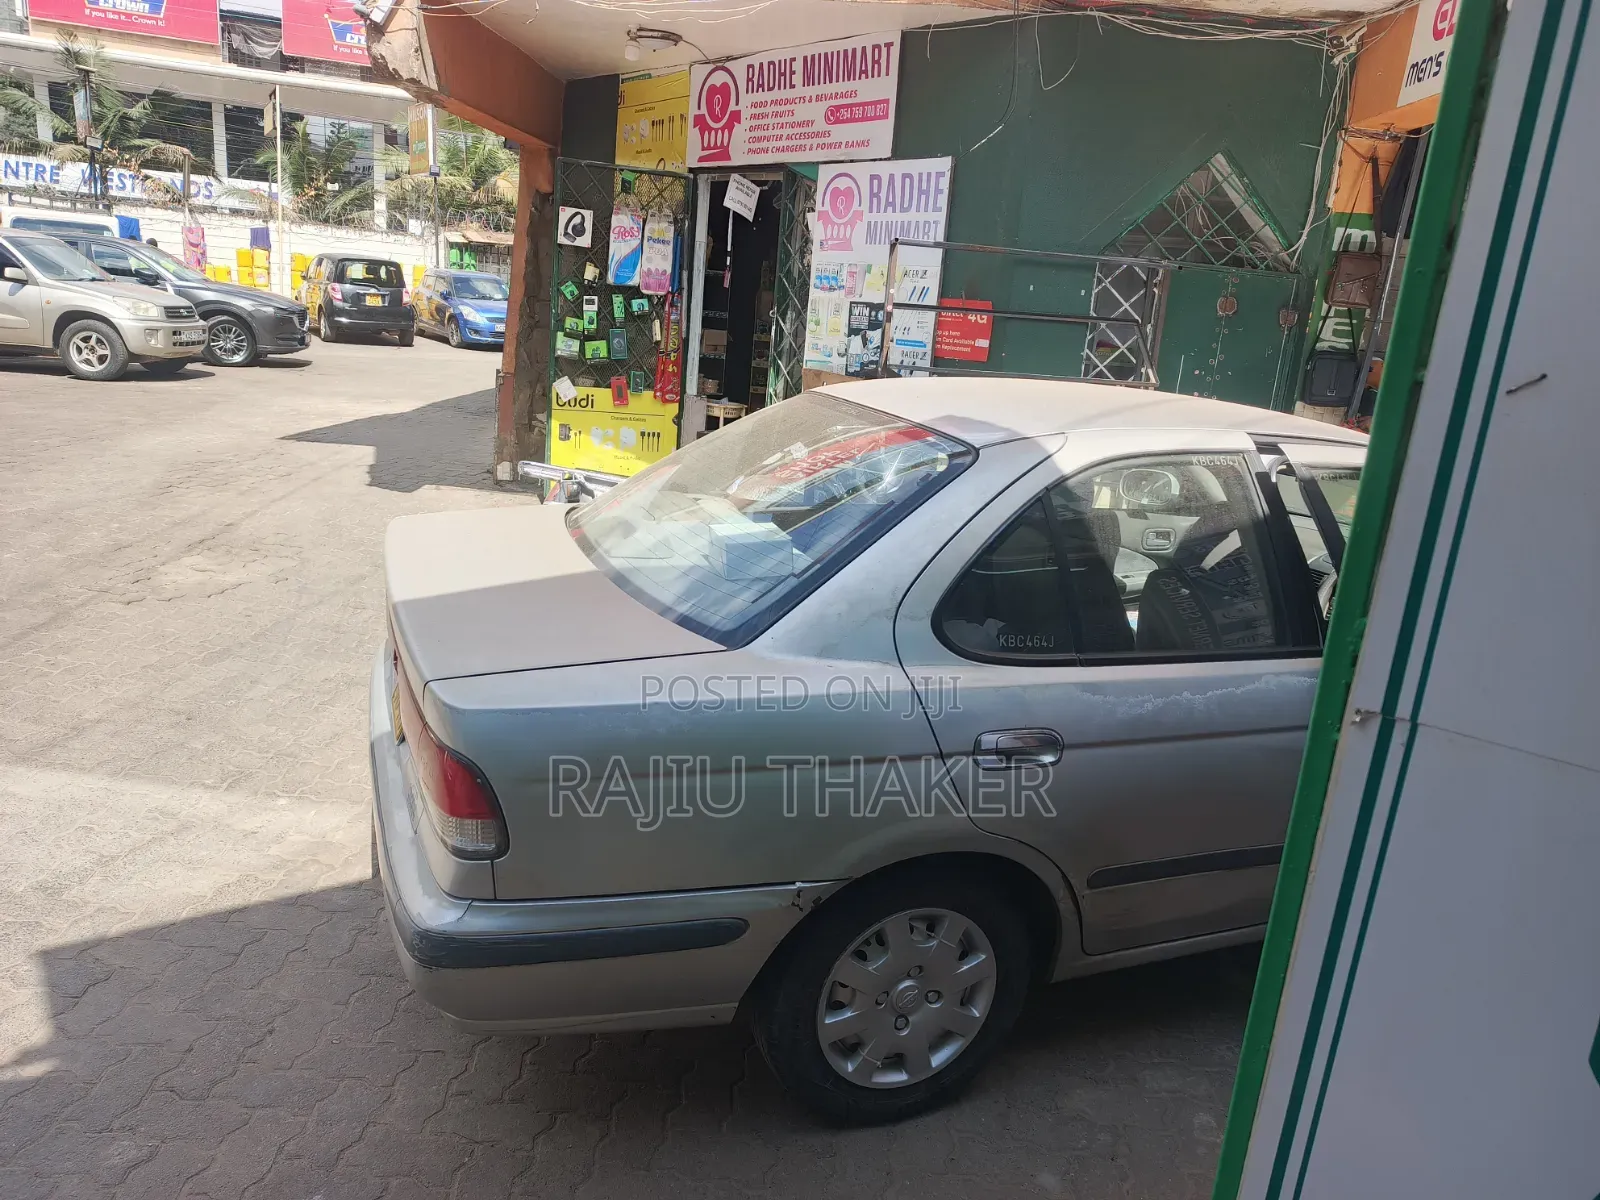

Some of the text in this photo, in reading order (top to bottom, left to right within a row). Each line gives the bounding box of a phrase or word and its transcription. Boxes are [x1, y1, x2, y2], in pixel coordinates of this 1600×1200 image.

[106, 11, 119, 19] like
[131, 15, 156, 26] Crown
[745, 41, 895, 95] RADHE MINIMART
[750, 89, 858, 110] FOOD PRODUCTS & BEVARAGES
[749, 109, 795, 121] FRESH FRUITS
[748, 119, 816, 133] OFFICE STATIONERY
[747, 129, 832, 144] COMPUTER ACCESSORIES
[746, 139, 871, 155] PHONE CHARGERS & POWER BANKS
[3, 159, 60, 184] NTRE
[868, 171, 946, 214] RADHE
[865, 220, 941, 245] MINIMART
[852, 306, 870, 317] WIN
[1191, 455, 1239, 466] KBC464J
[999, 634, 1055, 648] KBC464J
